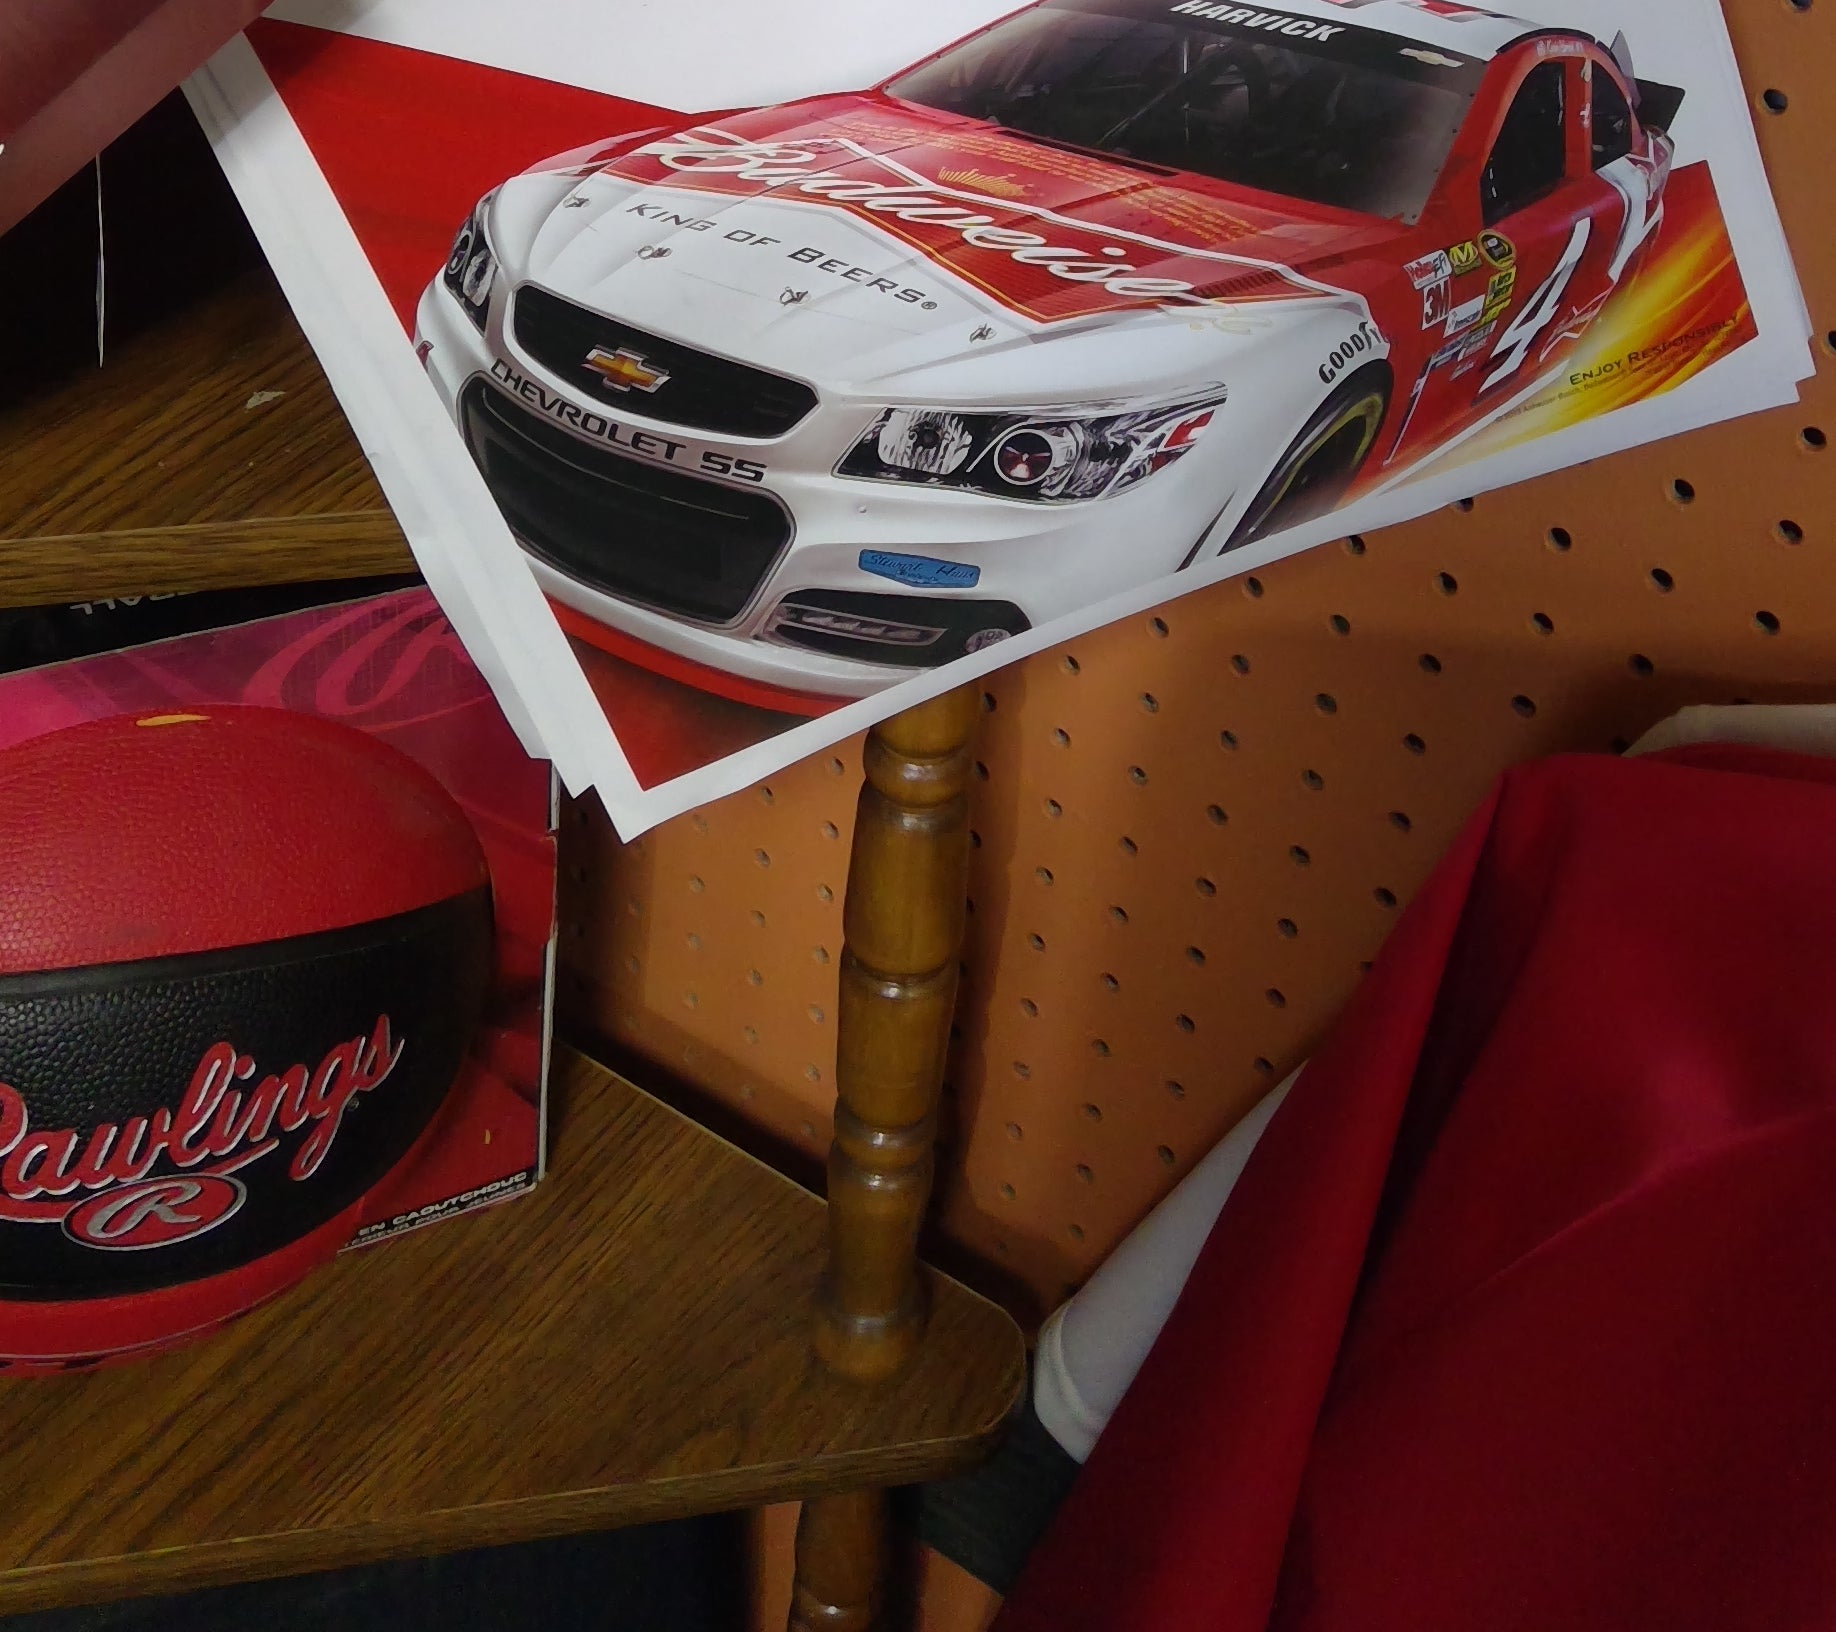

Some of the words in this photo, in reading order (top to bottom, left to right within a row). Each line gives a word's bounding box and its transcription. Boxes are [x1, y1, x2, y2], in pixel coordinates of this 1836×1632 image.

[1170, 0, 1346, 42] HARVICK
[626, 203, 717, 232] KING
[723, 229, 782, 247] OF
[1569, 358, 1623, 387] ENJOY
[490, 358, 687, 461] CHEVROLET
[700, 451, 768, 483] SS
[358, 1222, 386, 1237] EN
